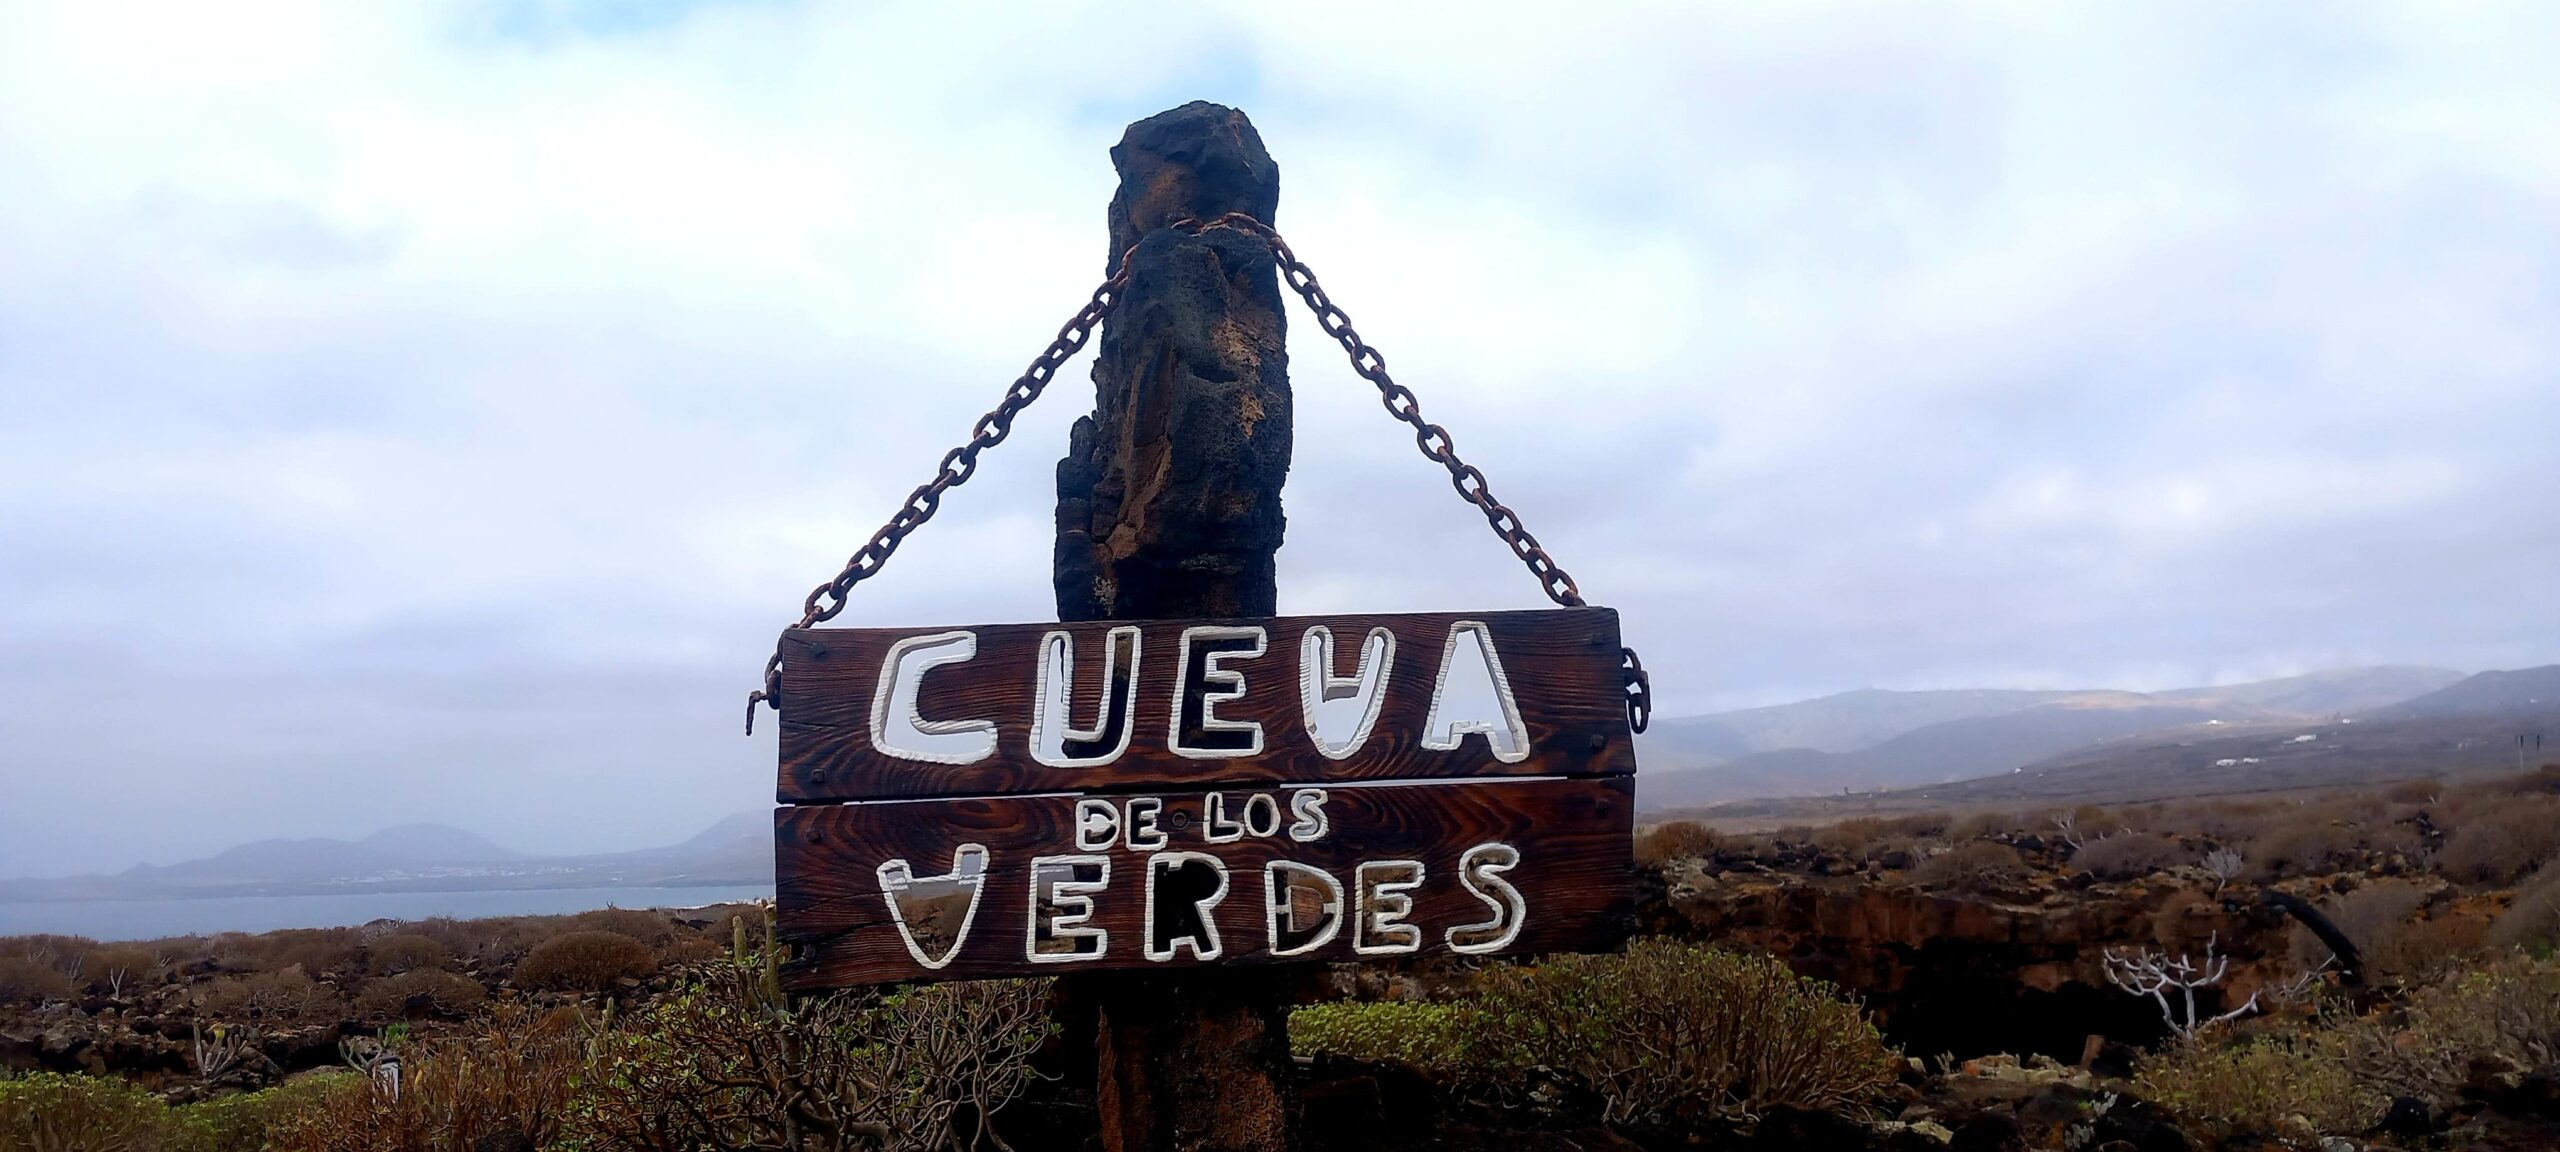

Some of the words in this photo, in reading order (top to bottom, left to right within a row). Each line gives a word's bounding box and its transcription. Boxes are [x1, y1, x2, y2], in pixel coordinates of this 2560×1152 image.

[870, 620, 1532, 767] CUEVA
[1074, 796, 1168, 851] DE
[1203, 788, 1328, 843] LOS
[876, 842, 1527, 969] VERDES
